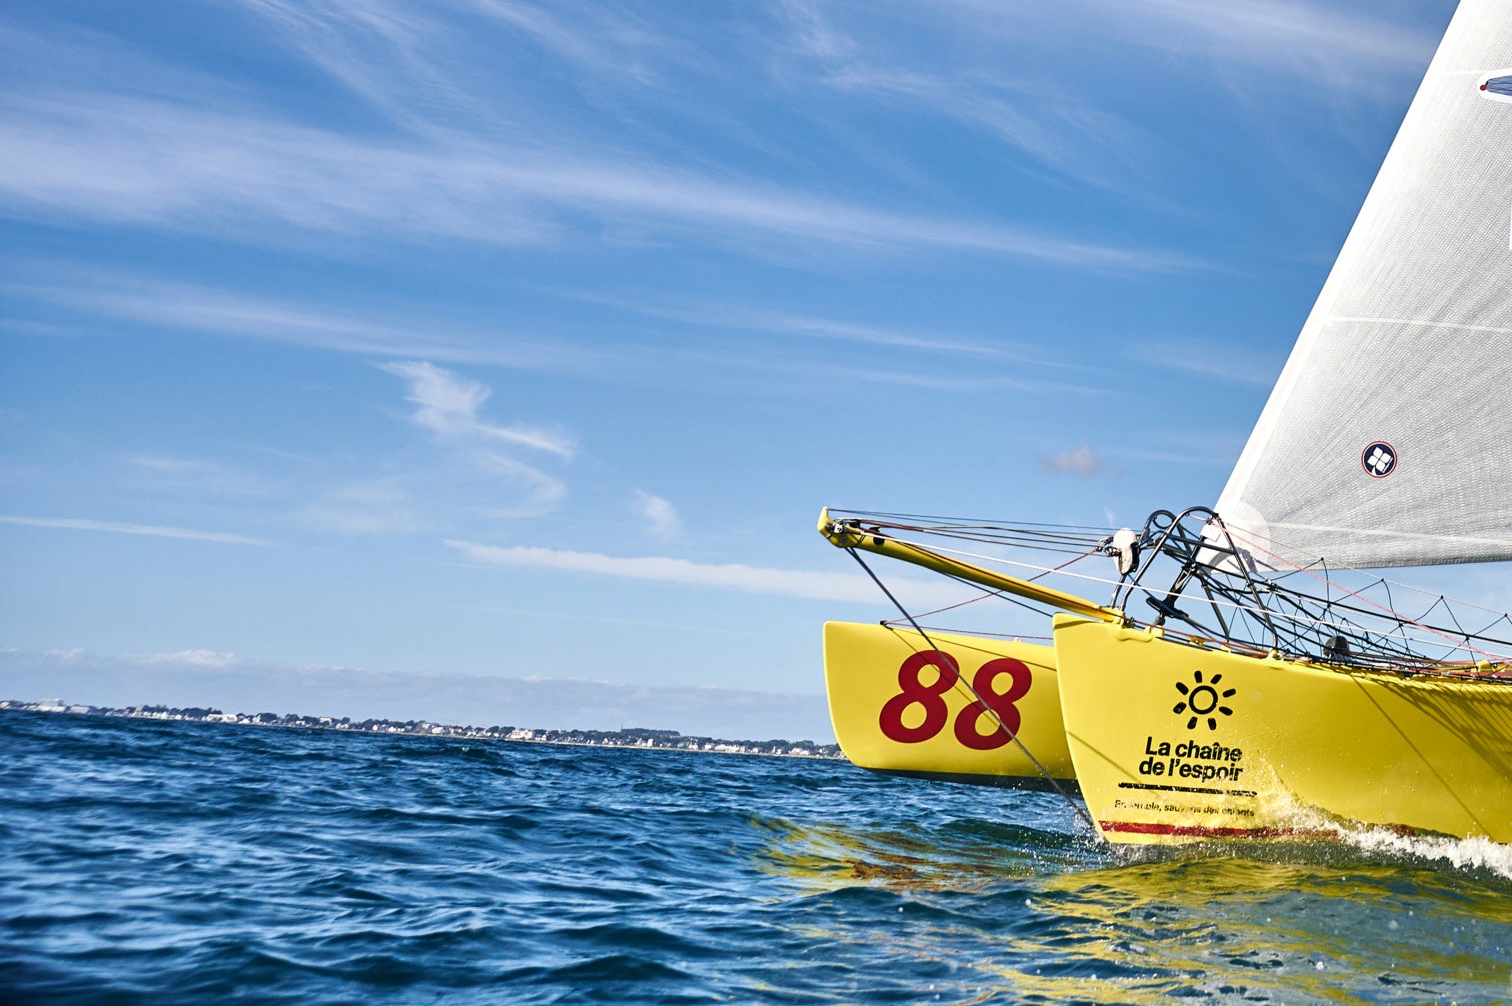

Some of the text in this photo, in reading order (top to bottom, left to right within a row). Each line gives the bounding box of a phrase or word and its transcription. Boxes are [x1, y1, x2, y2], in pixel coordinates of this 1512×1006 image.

[879, 650, 1032, 751] 88
[1145, 736, 1242, 762] La chaîne
[1139, 757, 1243, 783] de l'espoir
